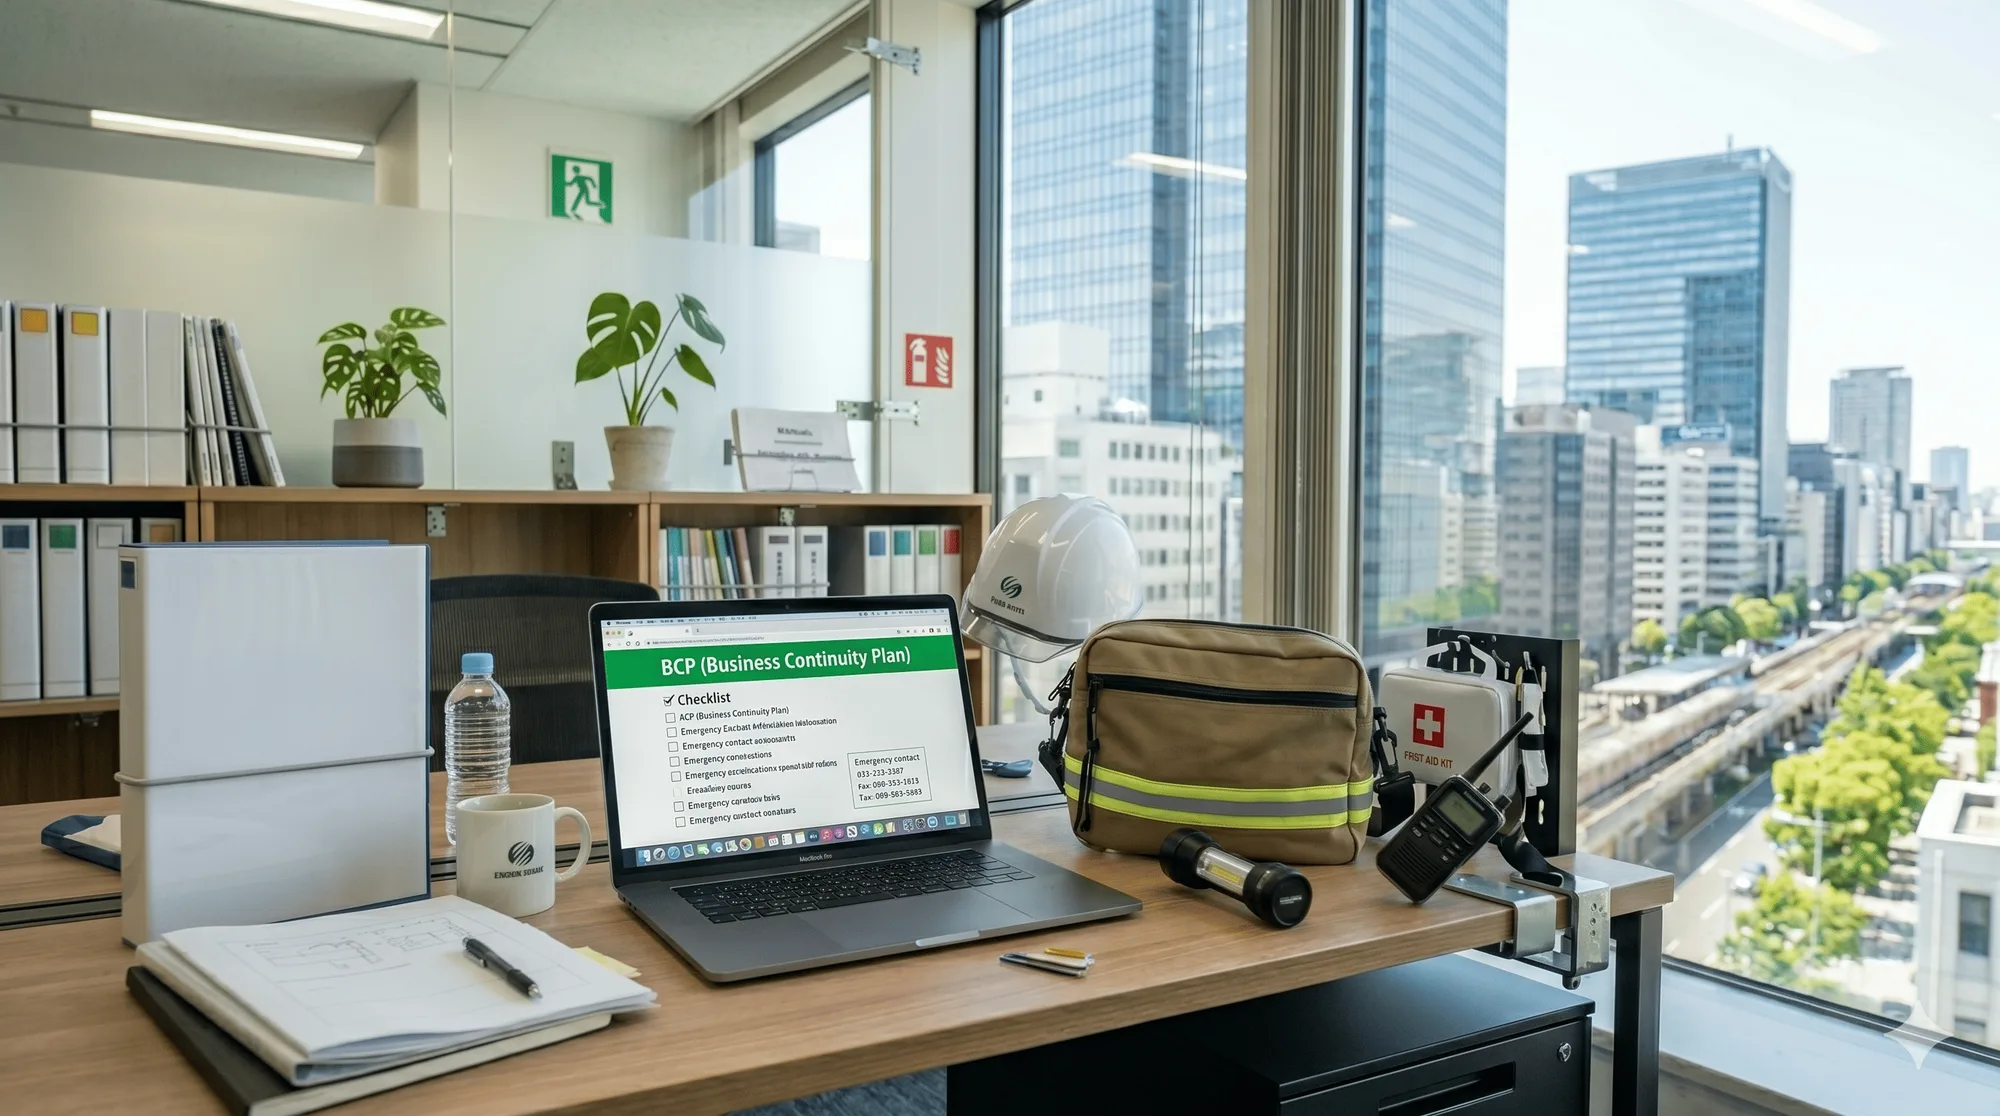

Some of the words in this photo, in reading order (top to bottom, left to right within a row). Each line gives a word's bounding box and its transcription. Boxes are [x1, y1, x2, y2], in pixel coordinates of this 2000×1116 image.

[661, 657, 696, 676] BCP
[701, 655, 781, 677] (Business
[785, 650, 867, 669] Continuity
[872, 646, 911, 664] Plan)
[677, 692, 731, 706] Checklist
[679, 713, 695, 722] ACP
[696, 711, 731, 721] (Business
[732, 708, 770, 718] Continuity
[771, 706, 790, 716] Plan)
[681, 726, 722, 737] Emergency
[682, 741, 724, 751] Emergency
[725, 738, 753, 747] contact
[683, 755, 725, 766] Emergency
[854, 757, 893, 767] Emergency
[893, 754, 921, 763] contact
[1425, 756, 1439, 766] AID
[1441, 759, 1453, 769] KIT
[685, 769, 727, 780] Emergency
[856, 767, 904, 778] 033-233-3387
[688, 799, 730, 810] Emergency
[689, 814, 732, 825] Emergency
